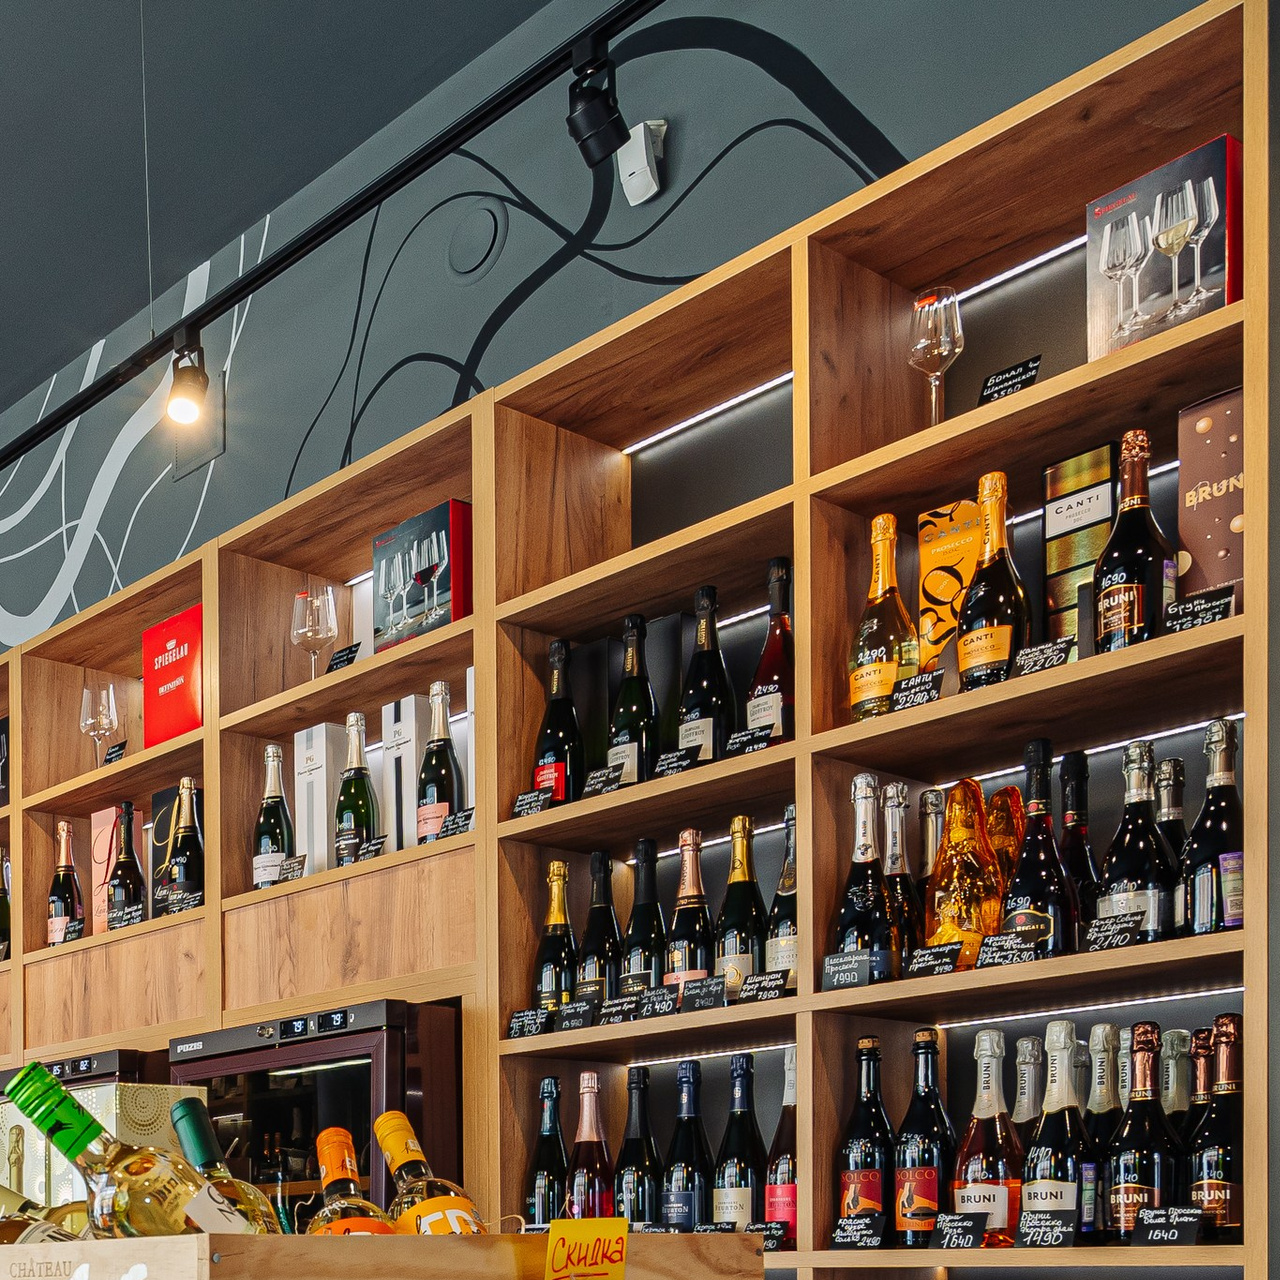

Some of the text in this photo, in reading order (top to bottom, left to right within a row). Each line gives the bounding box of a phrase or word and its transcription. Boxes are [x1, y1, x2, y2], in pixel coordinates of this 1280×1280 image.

[1055, 494, 1102, 515] CANTI
[983, 513, 991, 545] CANTI
[931, 536, 974, 555] PROSECCO
[1101, 572, 1127, 589] 1690
[963, 632, 994, 647] CANTI
[154, 643, 188, 670] SPIEGELAU
[858, 647, 886, 664] 2290
[854, 668, 882, 682] CANTI
[749, 704, 773, 716] GEOFFROY
[1089, 933, 1130, 952] 2140
[1002, 952, 1034, 965] 2690
[832, 971, 858, 986] 1990
[758, 990, 779, 999] 7990
[654, 1001, 673, 1013] 490
[177, 1041, 203, 1054] POZIS
[1097, 1057, 1105, 1085] BRUNI
[841, 1171, 880, 1181] SOLCO
[896, 1170, 936, 1180] SOLCO
[960, 1194, 996, 1204] BRUNI
[1027, 1190, 1063, 1201] BRUNI
[1110, 1193, 1148, 1204] BRUNI
[1192, 1190, 1230, 1201] BRUNI
[858, 1236, 881, 1246] 2490
[941, 1234, 973, 1248] 1640
[1023, 1231, 1063, 1246] 1490
[1148, 1229, 1178, 1240] 1640
[552, 1235, 625, 1274] Скидка
[10, 1258, 72, 1278] CHÂTEAU
